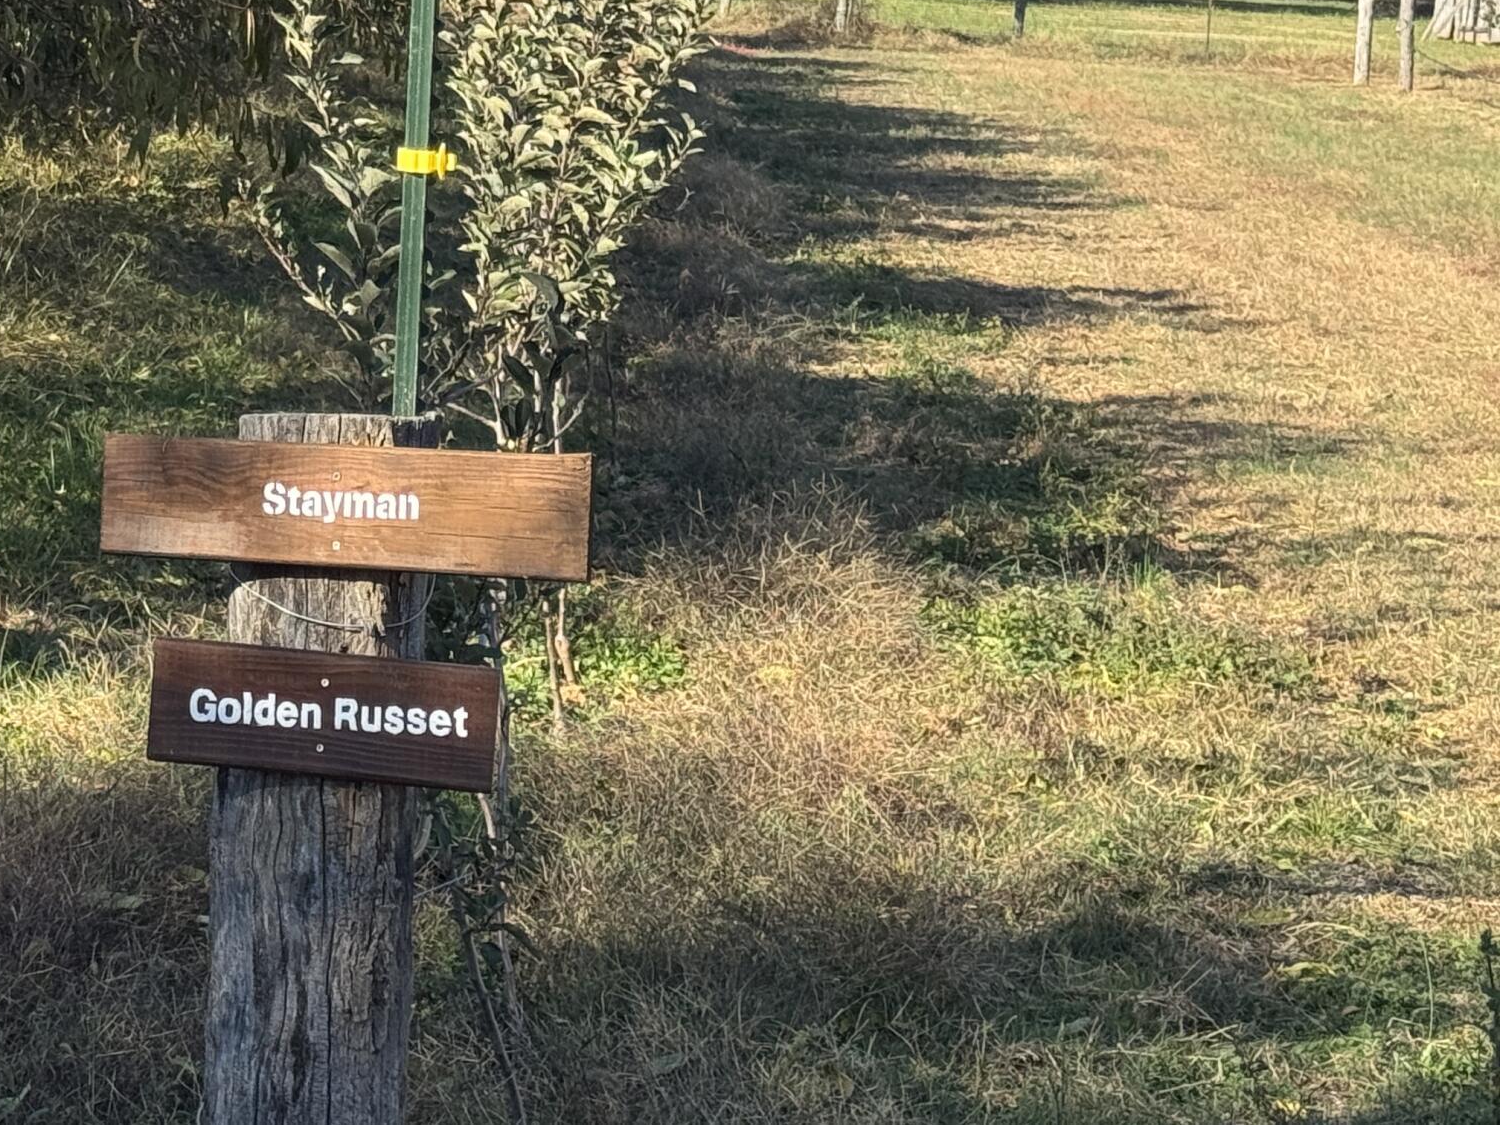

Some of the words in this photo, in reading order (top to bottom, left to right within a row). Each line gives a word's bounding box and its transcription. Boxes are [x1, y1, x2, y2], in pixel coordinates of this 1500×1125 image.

[262, 481, 420, 524] Stayman
[189, 688, 322, 729] Golden
[334, 697, 469, 738] Russet
